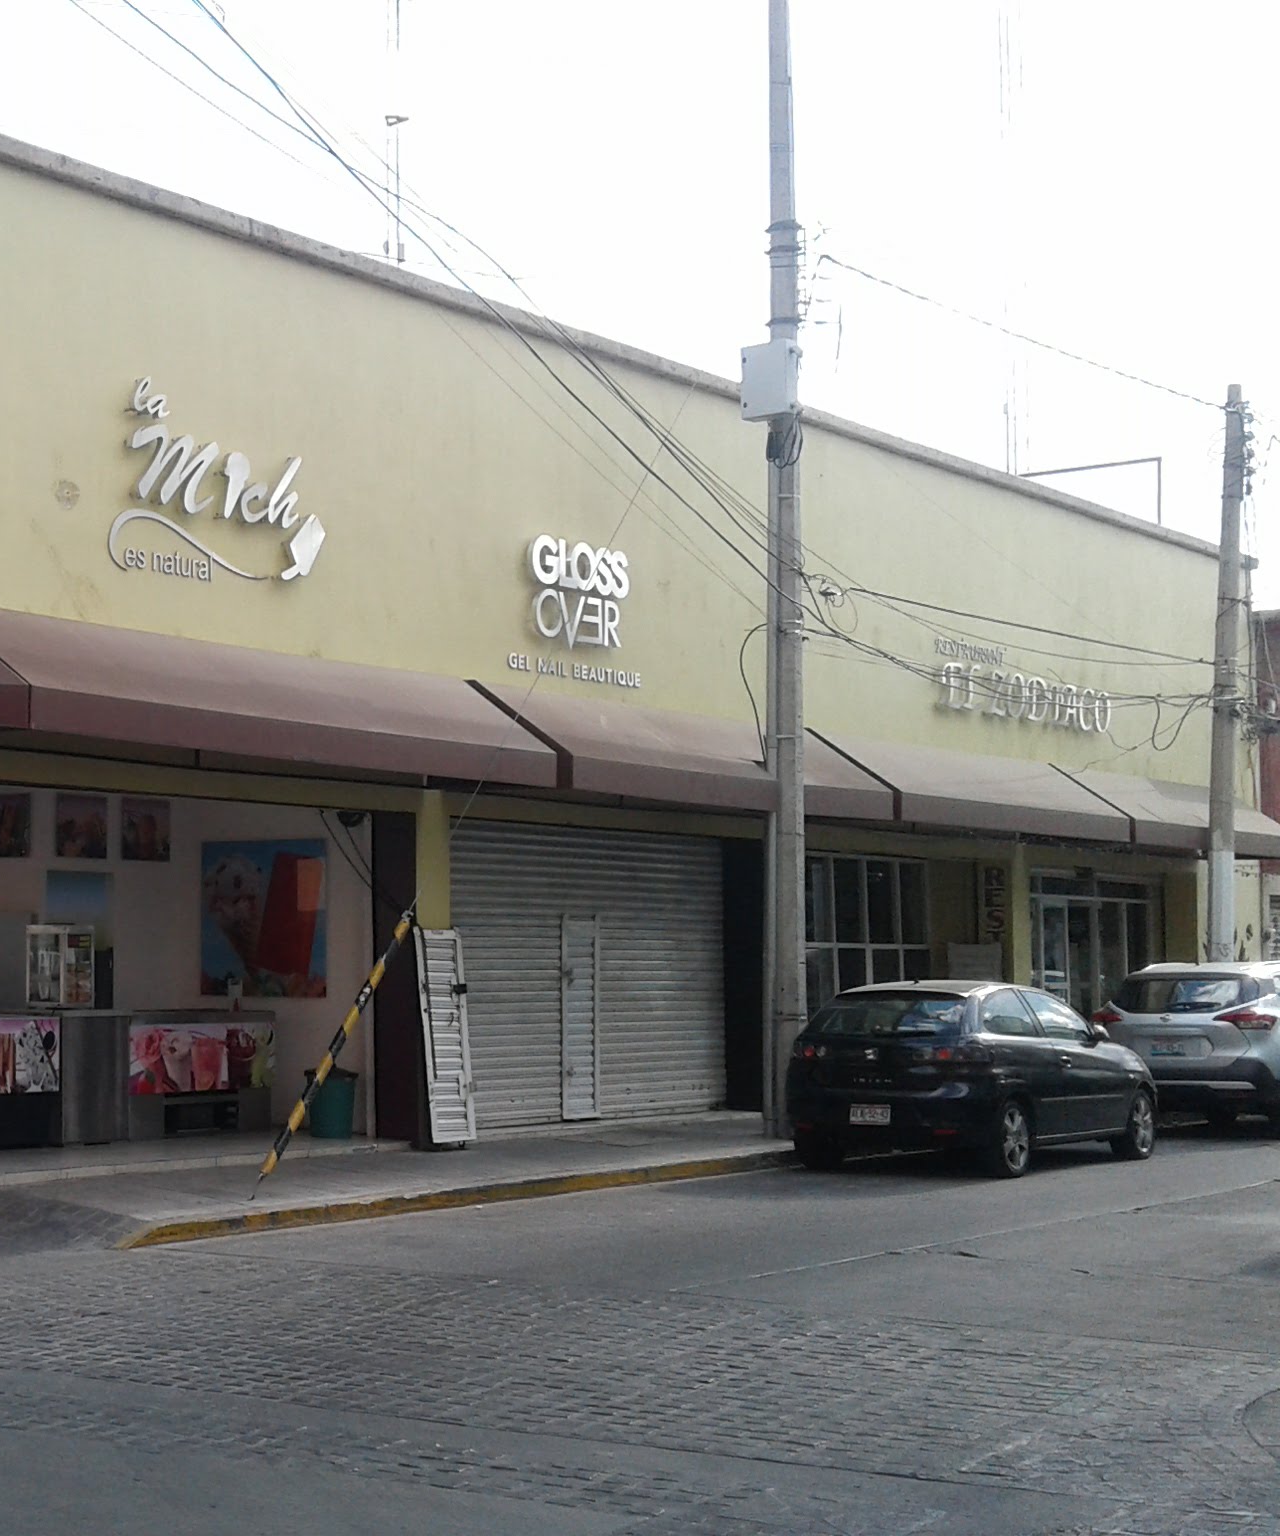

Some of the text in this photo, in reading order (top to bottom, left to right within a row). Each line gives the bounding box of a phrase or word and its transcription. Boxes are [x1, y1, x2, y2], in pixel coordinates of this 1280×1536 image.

[134, 376, 170, 419] la
[124, 546, 213, 582] es natural
[529, 534, 630, 599] GLOSS
[534, 588, 622, 649] OVER
[508, 651, 642, 688] GEL NAIL BEAUTIQUE
[940, 661, 1112, 733] EL ZODIACO
